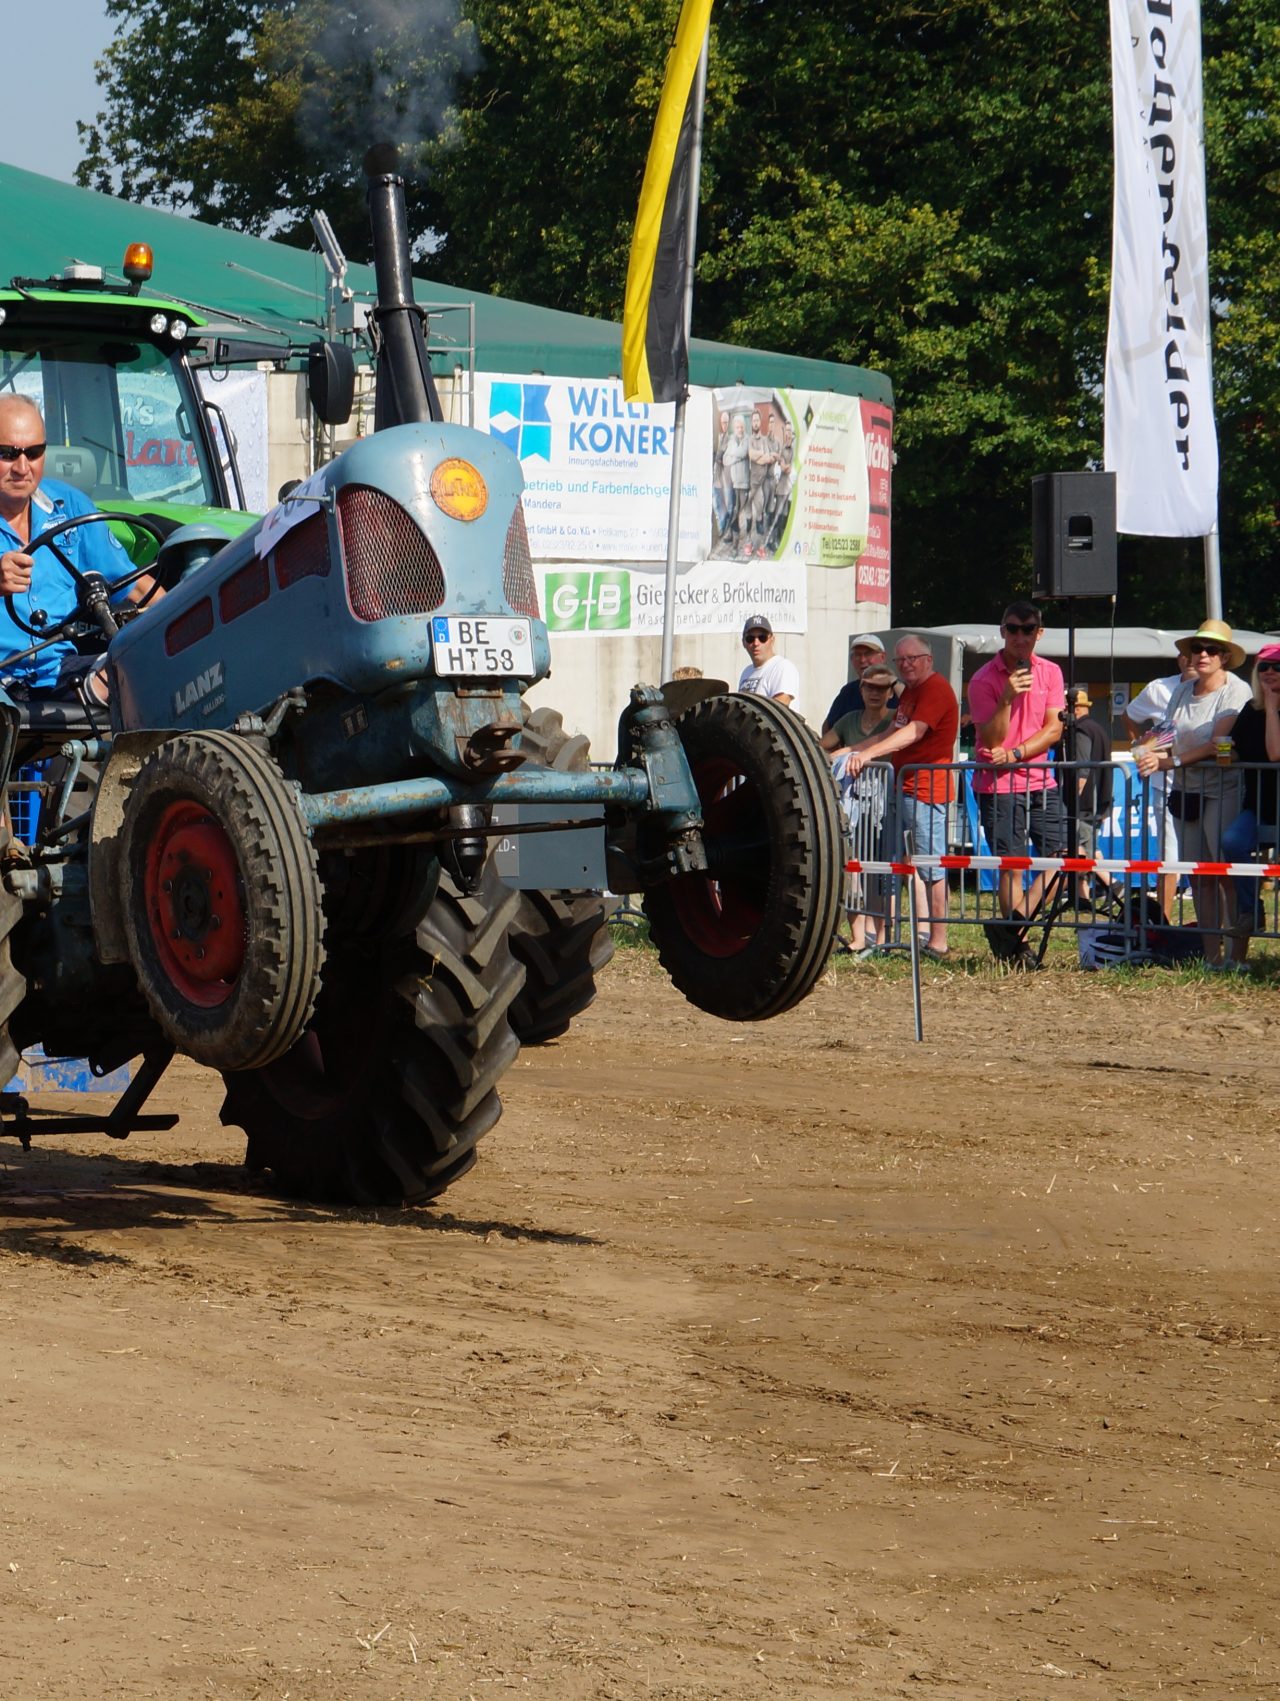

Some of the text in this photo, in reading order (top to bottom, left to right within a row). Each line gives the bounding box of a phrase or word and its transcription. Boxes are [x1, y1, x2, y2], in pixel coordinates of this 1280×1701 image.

[568, 481, 588, 493] und
[712, 589, 719, 603] &
[723, 581, 796, 604] Brökelmann
[718, 612, 734, 624] und
[439, 633, 445, 641] D
[459, 622, 489, 645] BE
[448, 648, 514, 671] HT 58
[175, 662, 223, 715] LANZ
